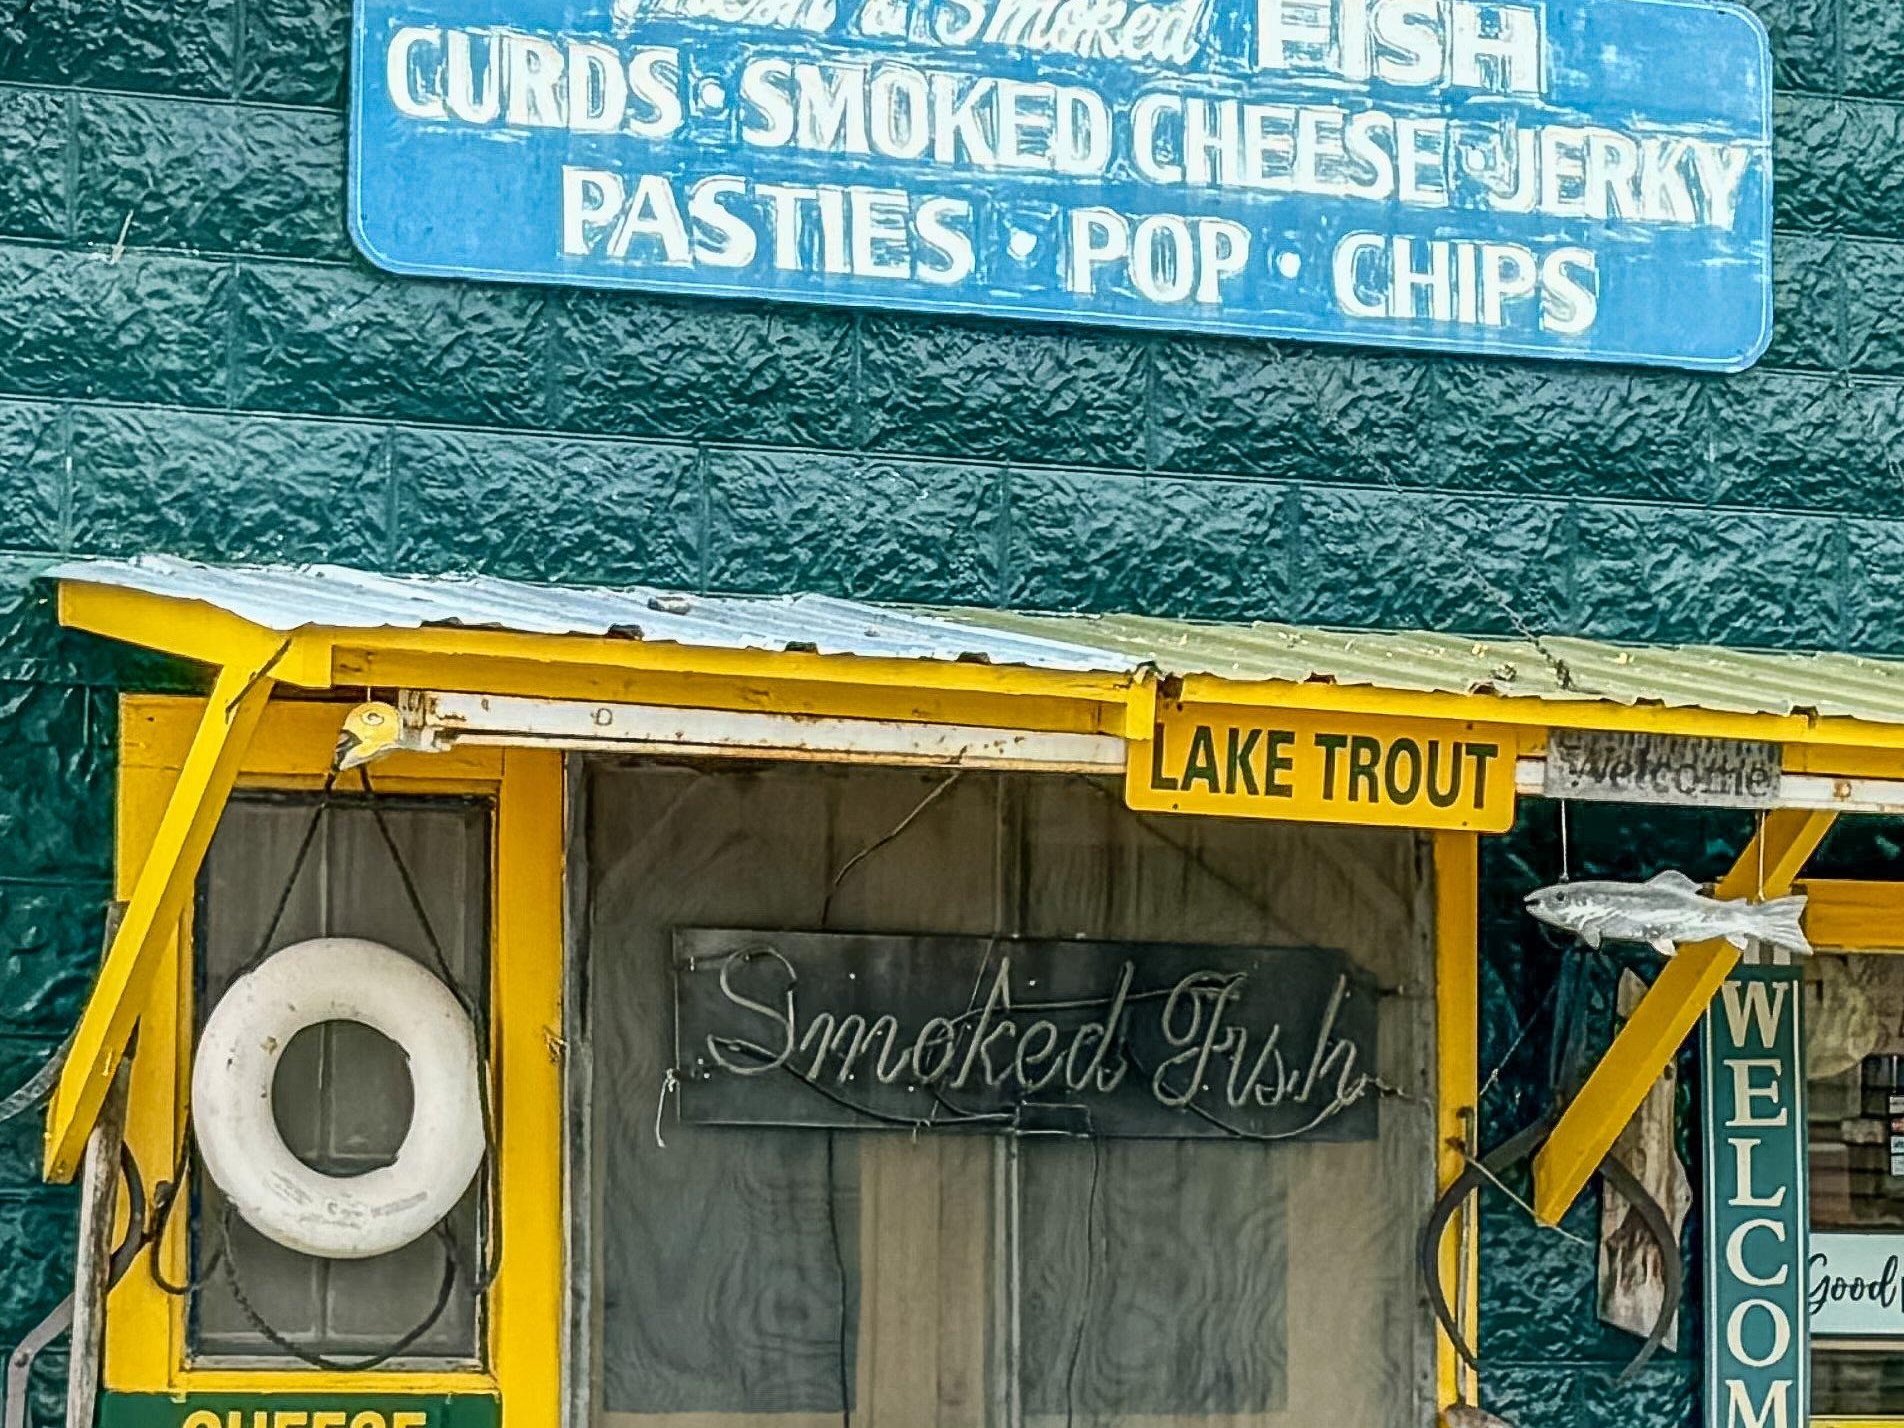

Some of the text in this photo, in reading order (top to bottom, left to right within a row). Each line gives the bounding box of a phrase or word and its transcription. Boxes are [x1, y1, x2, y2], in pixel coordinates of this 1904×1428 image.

[386, 24, 1752, 230] CURDS SMOKED CHEESE JERKY
[559, 165, 1602, 336] PASTIES POP CHIPS
[1148, 721, 1499, 812] LAKE TROUT
[707, 945, 1364, 1108] Smoked Fish
[1809, 1252, 1898, 1316] Good
